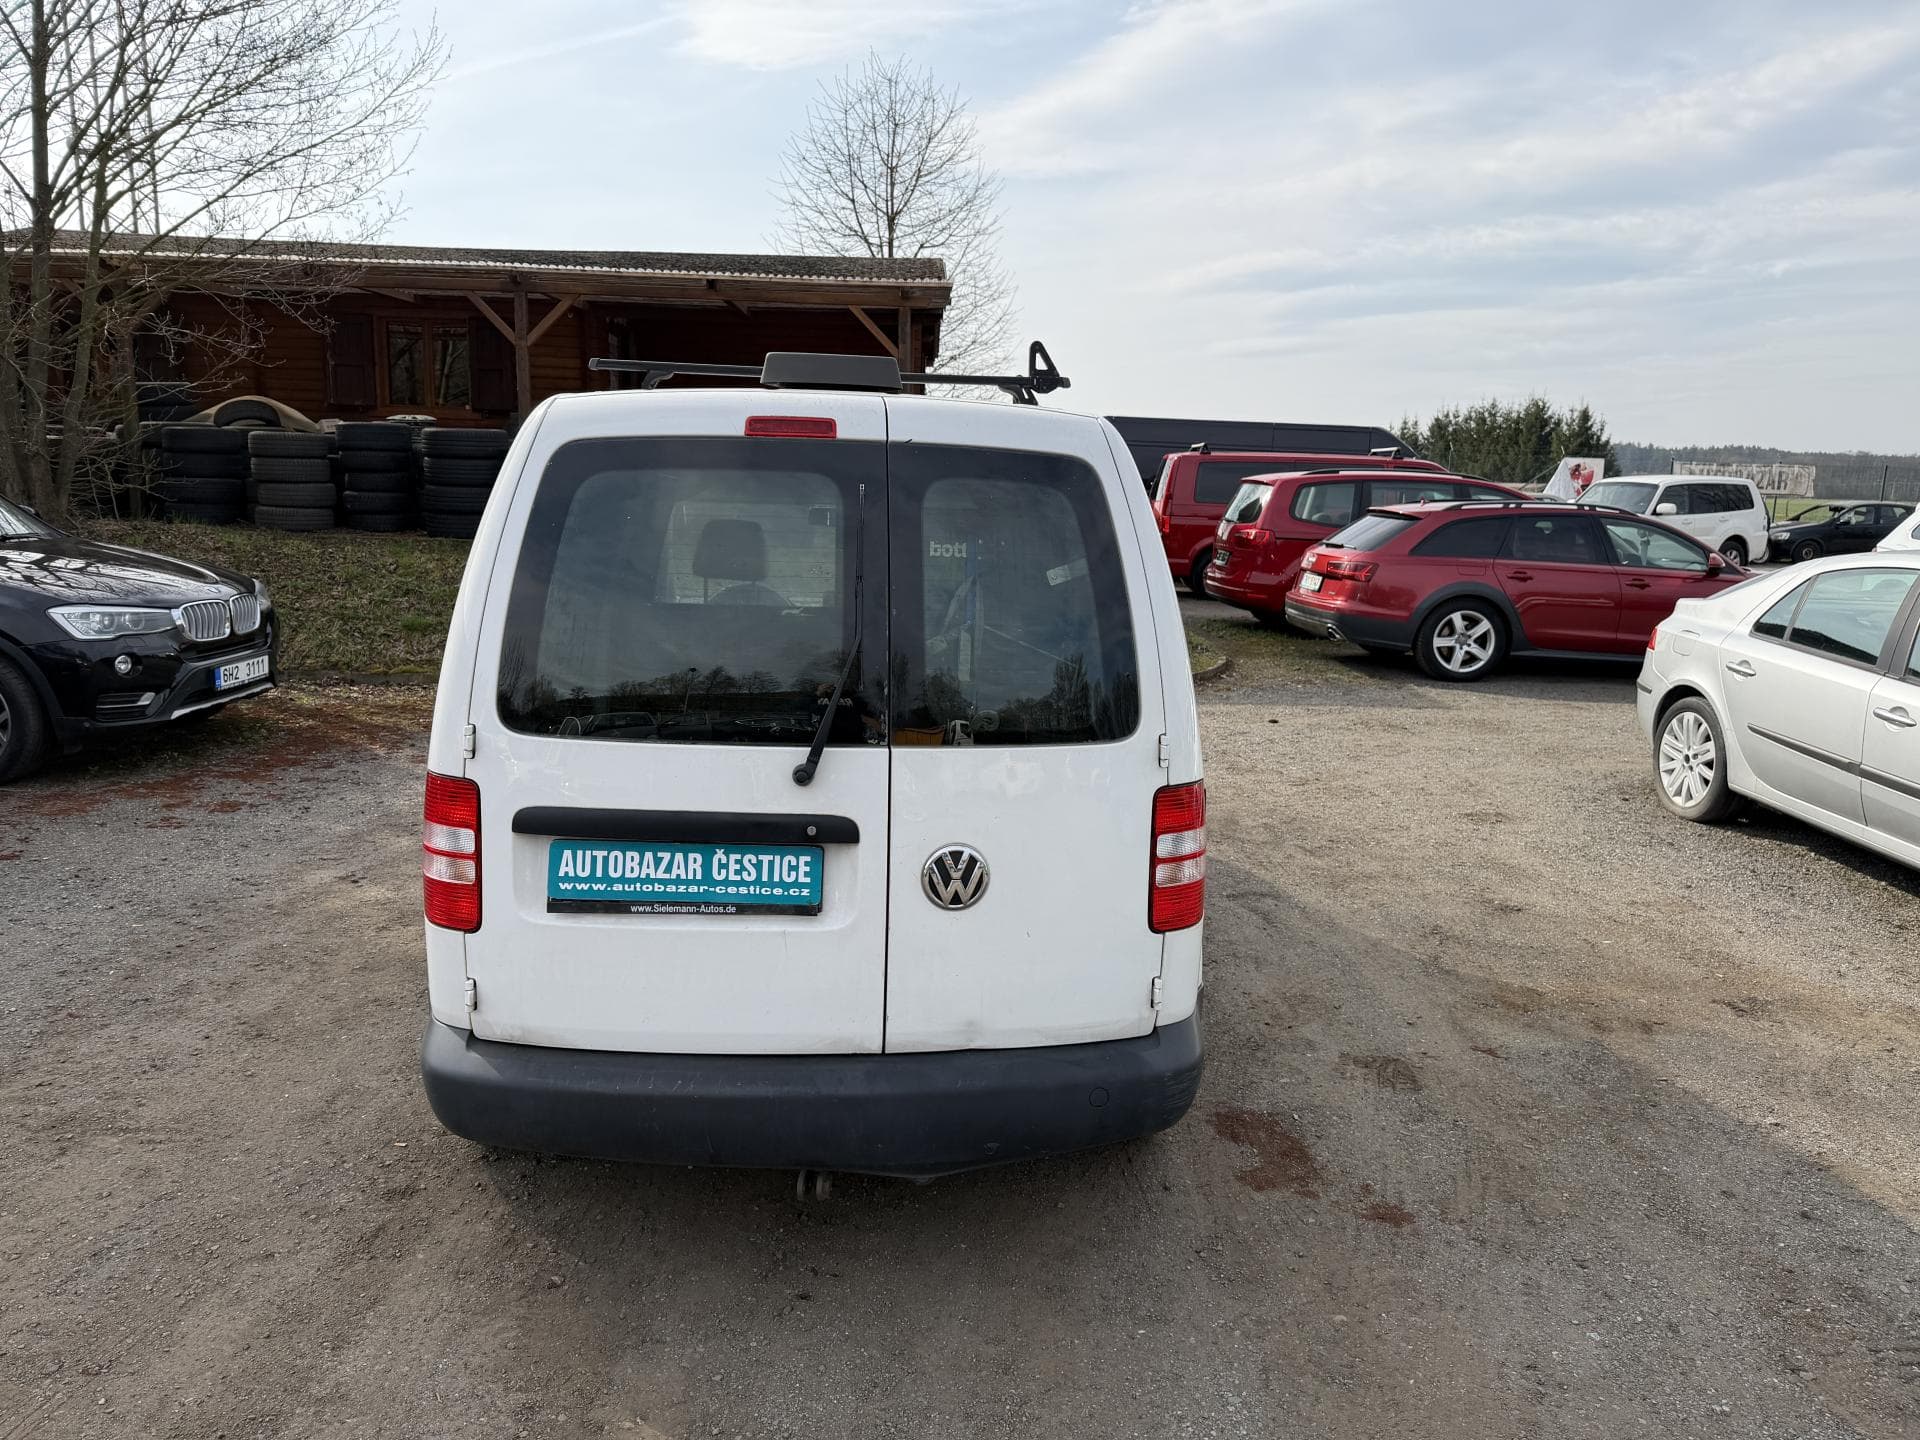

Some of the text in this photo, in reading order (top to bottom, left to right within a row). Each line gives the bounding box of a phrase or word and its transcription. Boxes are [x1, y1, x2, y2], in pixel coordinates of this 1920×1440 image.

[222, 658, 265, 683] 6H2 3111
[558, 849, 812, 883] AUTOBAZAR ČESTICE
[558, 882, 811, 896] www.autobazar-cestice.cz
[630, 903, 737, 913] www.Sielemann-Autos.de
